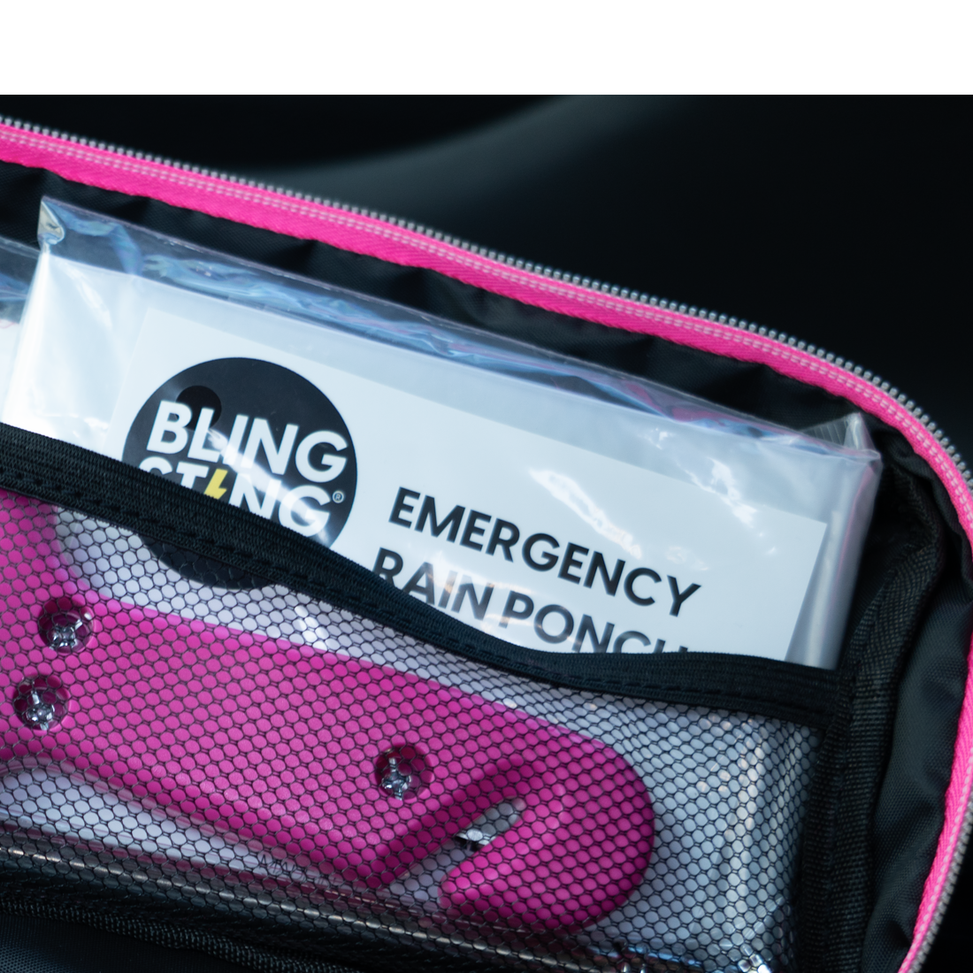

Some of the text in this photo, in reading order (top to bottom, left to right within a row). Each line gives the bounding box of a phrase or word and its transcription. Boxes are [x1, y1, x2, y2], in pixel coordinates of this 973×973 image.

[145, 399, 348, 483] BLING
[372, 547, 494, 621] RAIN
[388, 486, 702, 617] EMERGENCY
